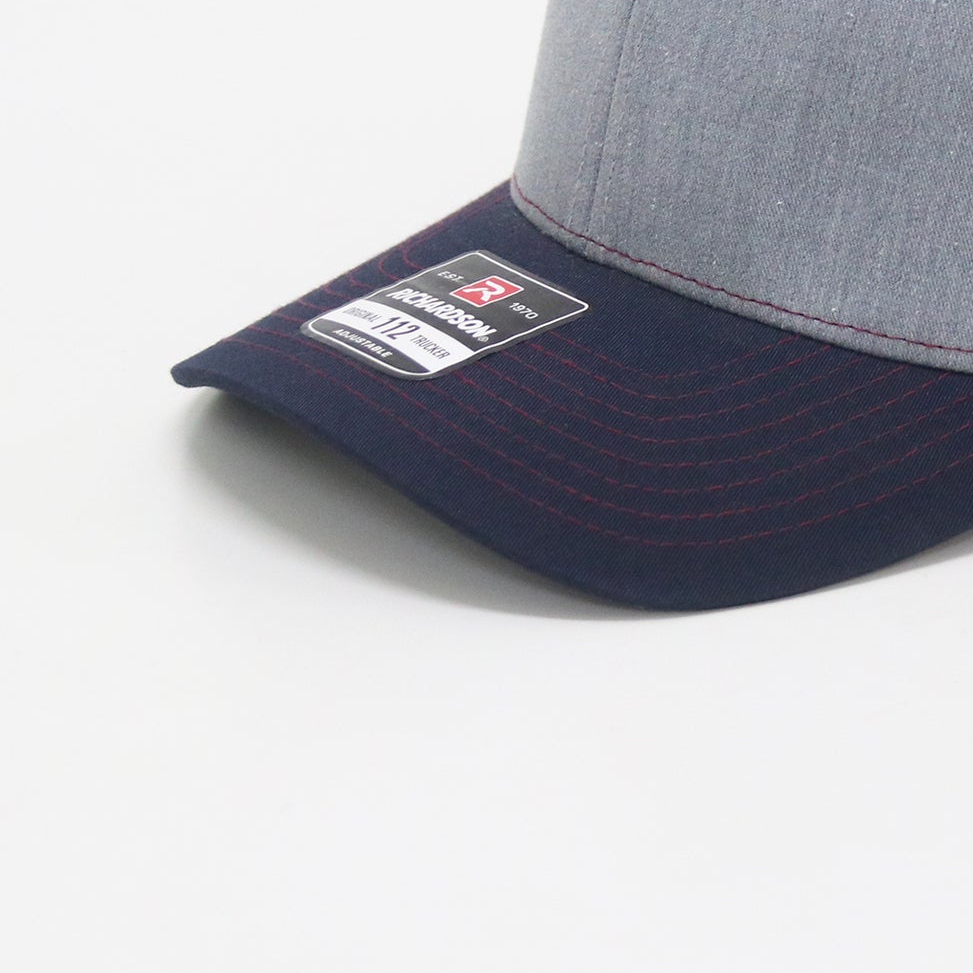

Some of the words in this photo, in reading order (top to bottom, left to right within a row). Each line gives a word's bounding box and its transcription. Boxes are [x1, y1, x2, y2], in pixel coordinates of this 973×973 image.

[437, 270, 464, 283] EST.
[508, 301, 540, 320] 1970
[332, 328, 394, 358] ADJUSTABLE
[371, 315, 418, 341] 112
[410, 334, 452, 359] TRUCKER
